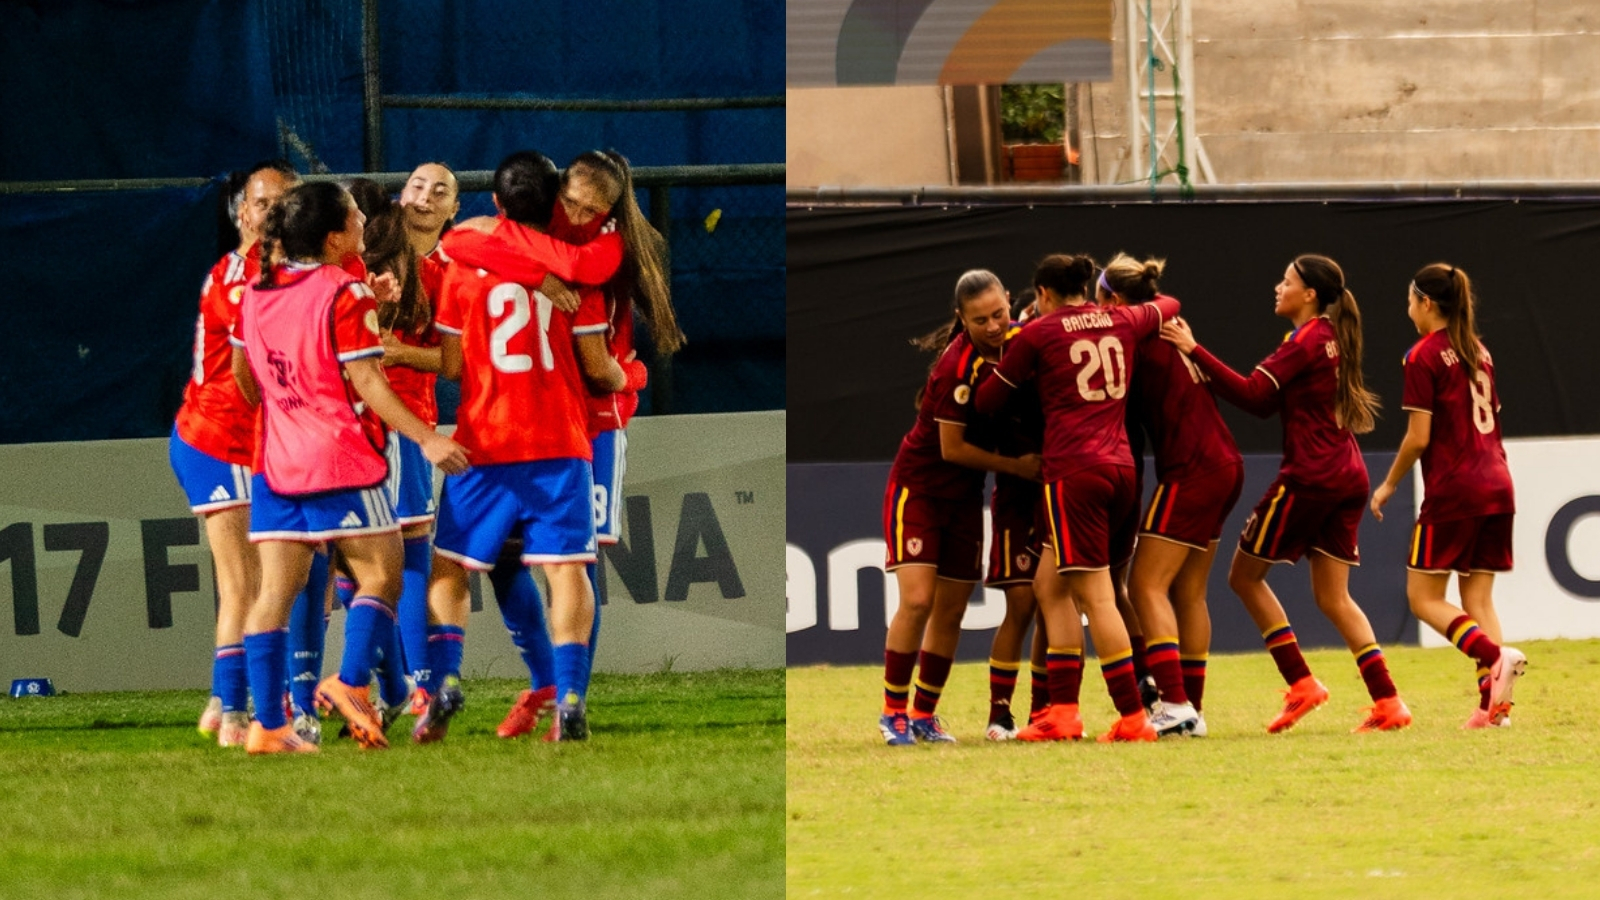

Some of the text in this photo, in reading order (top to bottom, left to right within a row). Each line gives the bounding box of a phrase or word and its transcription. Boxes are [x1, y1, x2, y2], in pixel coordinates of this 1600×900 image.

[487, 282, 555, 373] 21
[1069, 335, 1126, 401] 20
[1469, 370, 1495, 434] 8
[0, 521, 110, 638] 17
